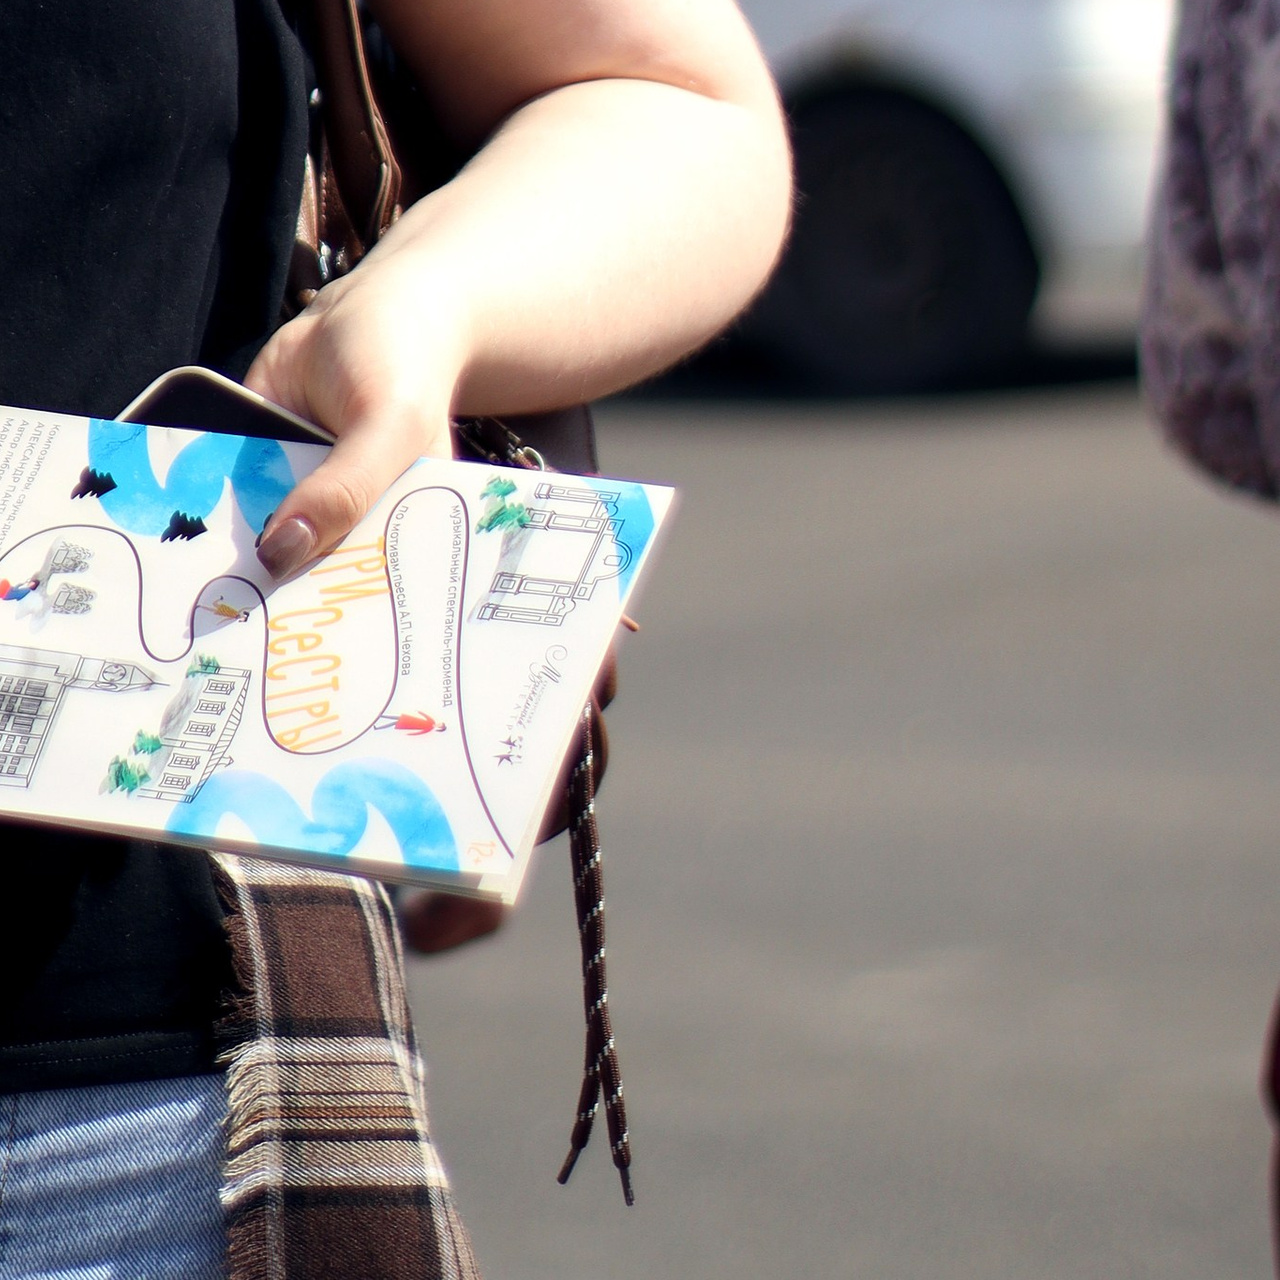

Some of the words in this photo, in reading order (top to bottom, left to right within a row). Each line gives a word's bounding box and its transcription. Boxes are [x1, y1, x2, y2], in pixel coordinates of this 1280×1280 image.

[9, 419, 30, 449] Автор
[12, 421, 45, 483] АЛЕКСАНДР
[23, 424, 62, 492] Композиторы,
[395, 505, 409, 521] по
[388, 523, 401, 575] мотивам
[448, 504, 463, 584] музыкальный
[309, 535, 391, 606] ТРИ
[392, 575, 406, 611] пьесы
[399, 610, 412, 634] А.П.
[401, 635, 414, 676] Чехова
[440, 586, 458, 708] спектакль-променад
[467, 841, 496, 865] 12+
